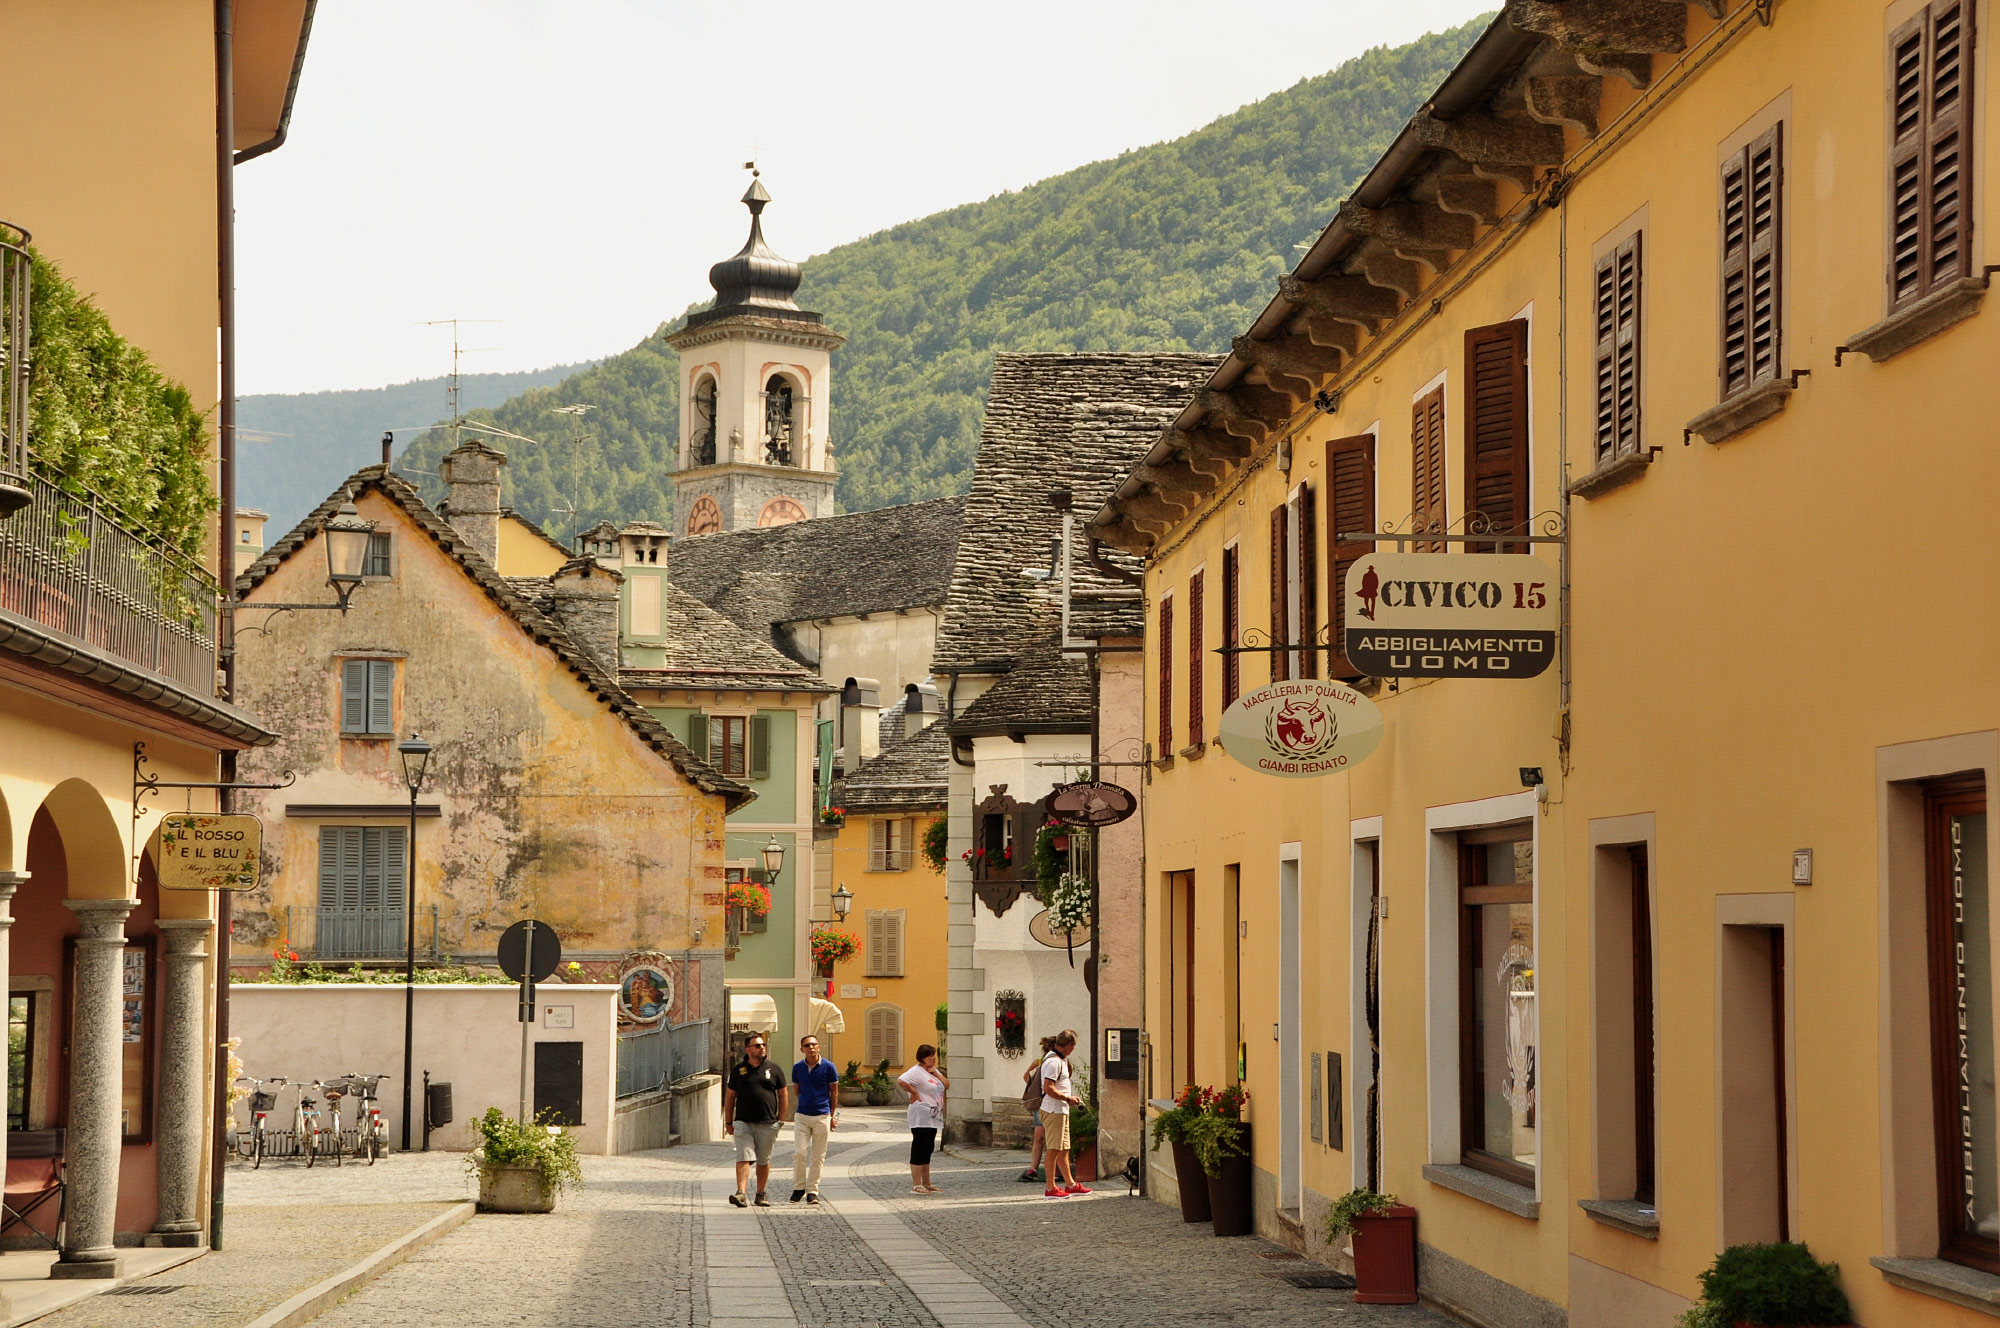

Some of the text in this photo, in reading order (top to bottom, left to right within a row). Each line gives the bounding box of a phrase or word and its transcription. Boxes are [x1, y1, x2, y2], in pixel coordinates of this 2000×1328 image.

[1380, 580, 1546, 609] CIVICO 15
[1358, 636, 1543, 653] ABBIGLIAMENTO
[1390, 655, 1510, 670] UOMO
[1242, 685, 1302, 711] MACELLERIA
[1315, 685, 1358, 707] QUALITÀ
[1258, 754, 1348, 773] GIAMBI RENATO
[1068, 783, 1091, 792] Scarpa
[177, 829, 245, 841] IL ROSSO
[181, 847, 239, 859] E IL BLU
[1953, 822, 1964, 923] UOMO
[1956, 942, 1975, 1221] ABBIGLIAMENTO
